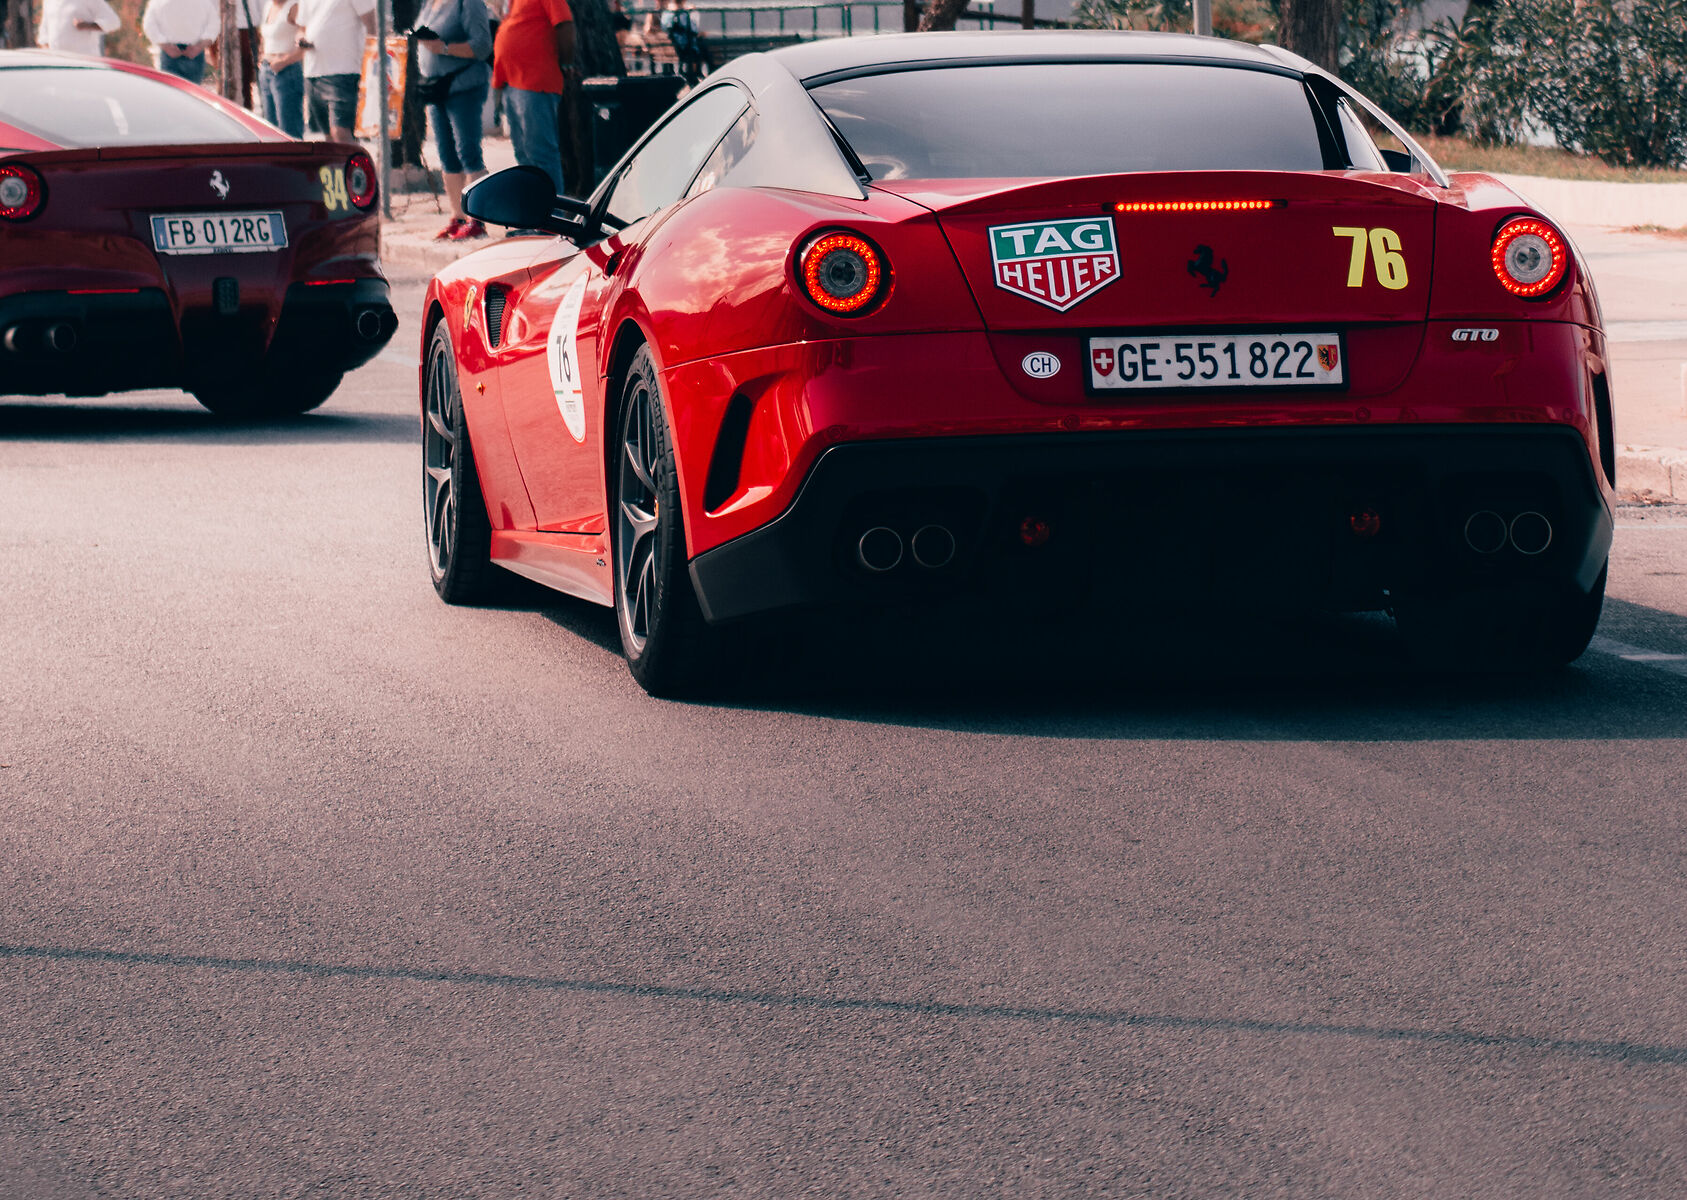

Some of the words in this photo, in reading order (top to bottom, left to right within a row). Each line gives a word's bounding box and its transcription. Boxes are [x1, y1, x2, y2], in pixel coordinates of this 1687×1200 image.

[319, 166, 349, 211] 34
[1000, 224, 1104, 255] TAG
[1332, 226, 1408, 290] 76
[1002, 256, 1112, 303] HEUER
[1452, 328, 1500, 342] GTO
[556, 334, 572, 383] 76
[1030, 357, 1052, 373] CH
